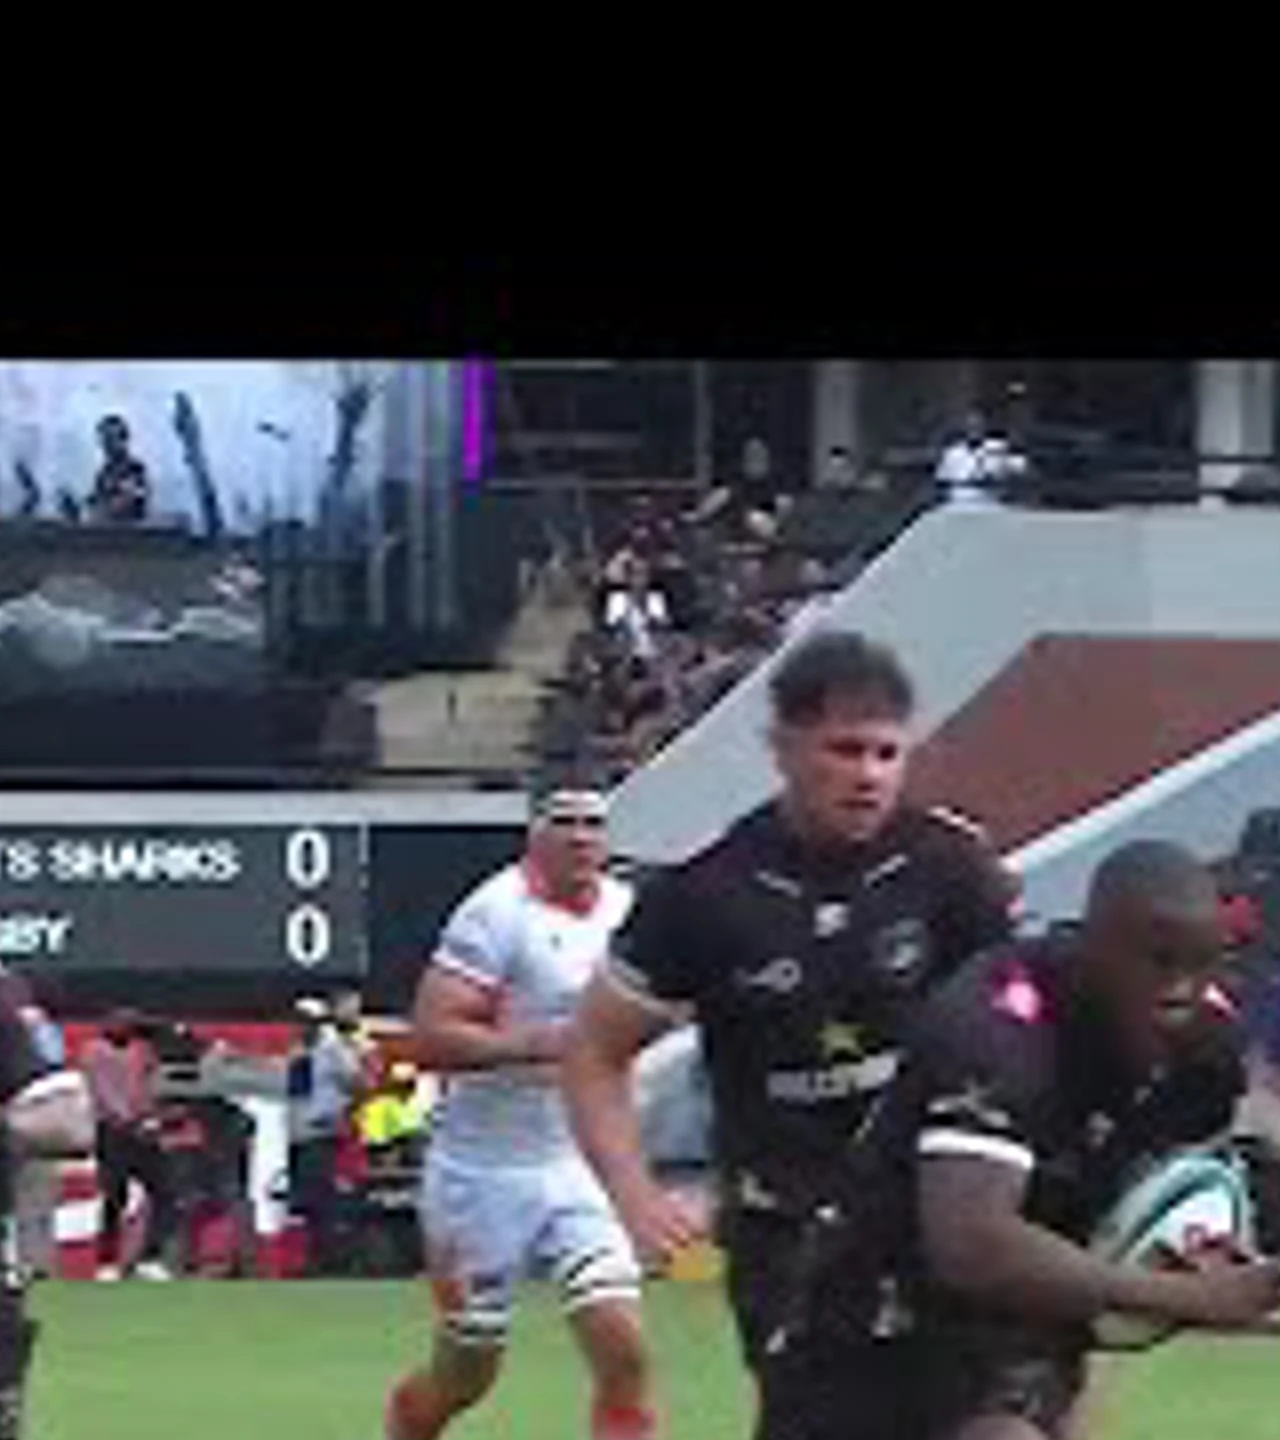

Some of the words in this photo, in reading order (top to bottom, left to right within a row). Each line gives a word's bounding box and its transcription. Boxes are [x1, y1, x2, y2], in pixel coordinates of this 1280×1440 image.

[47, 837, 243, 882] SHARKS
[285, 829, 331, 890] 0
[285, 904, 331, 966] 0
